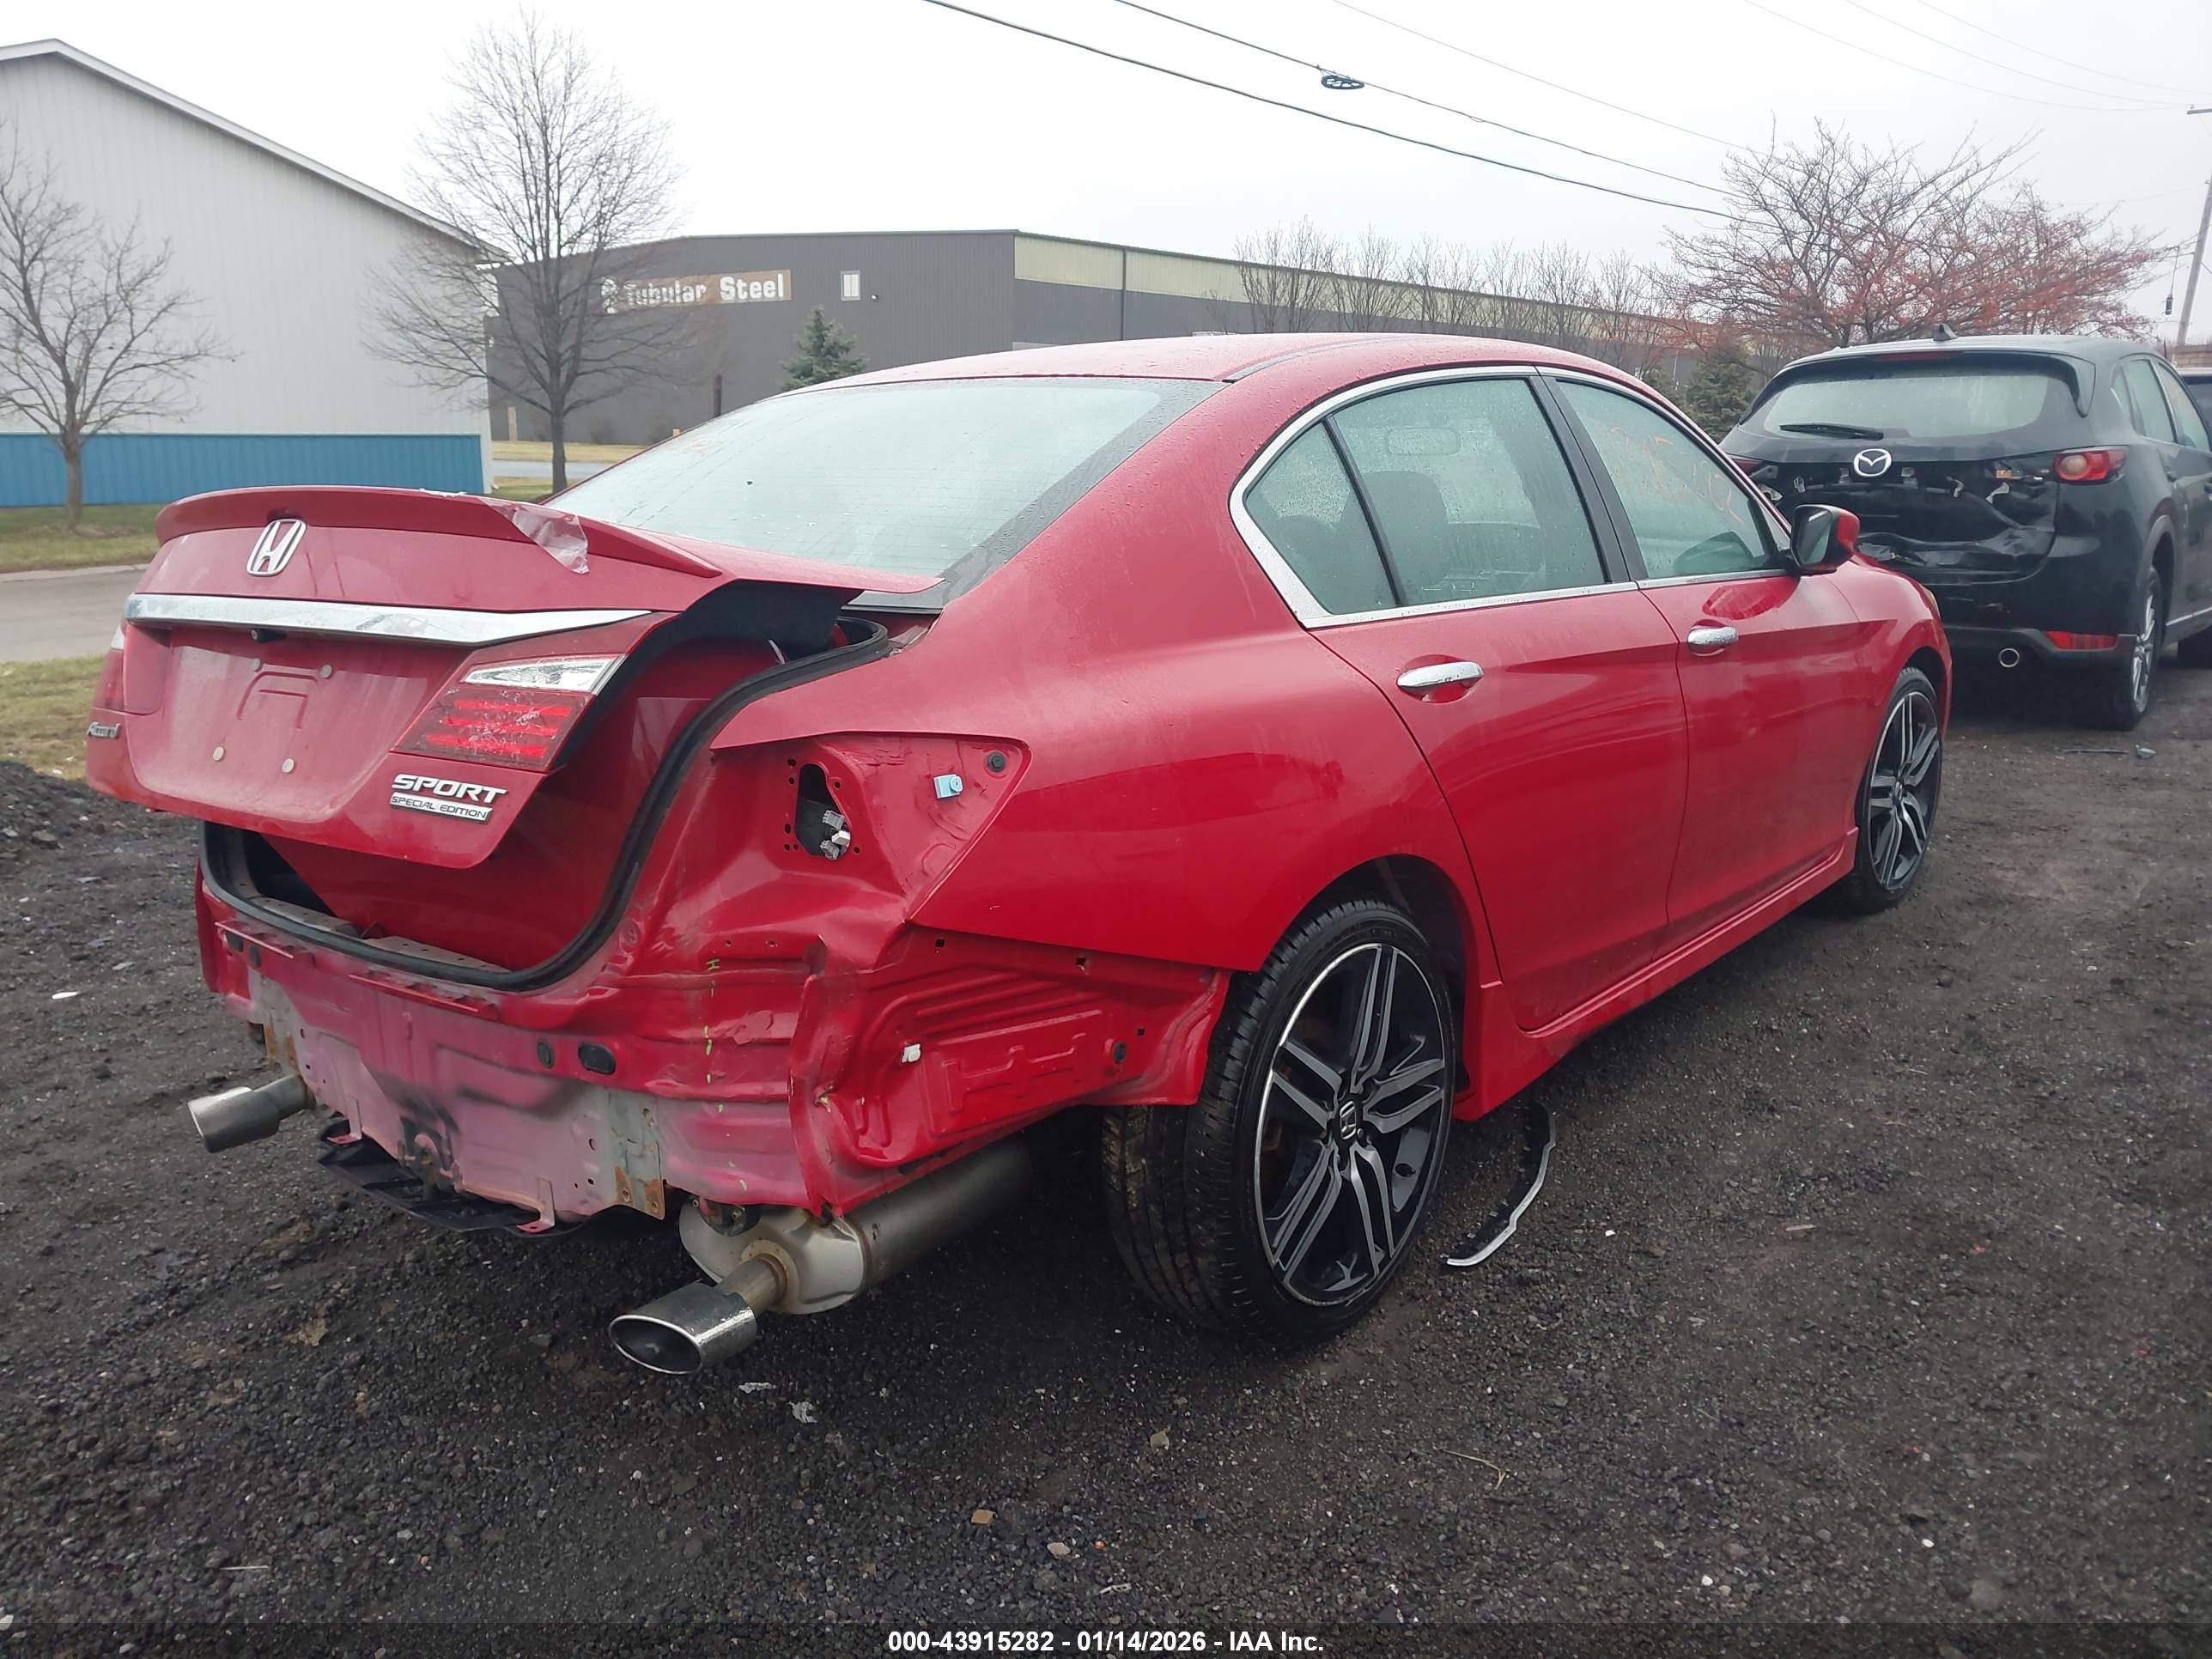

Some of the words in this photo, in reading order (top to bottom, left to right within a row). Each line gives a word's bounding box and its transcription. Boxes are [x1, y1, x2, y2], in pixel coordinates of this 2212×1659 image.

[720, 273, 784, 301] Steel
[392, 774, 508, 804] SPORT
[392, 795, 436, 810] SPECIAL
[440, 804, 488, 818] EDITION
